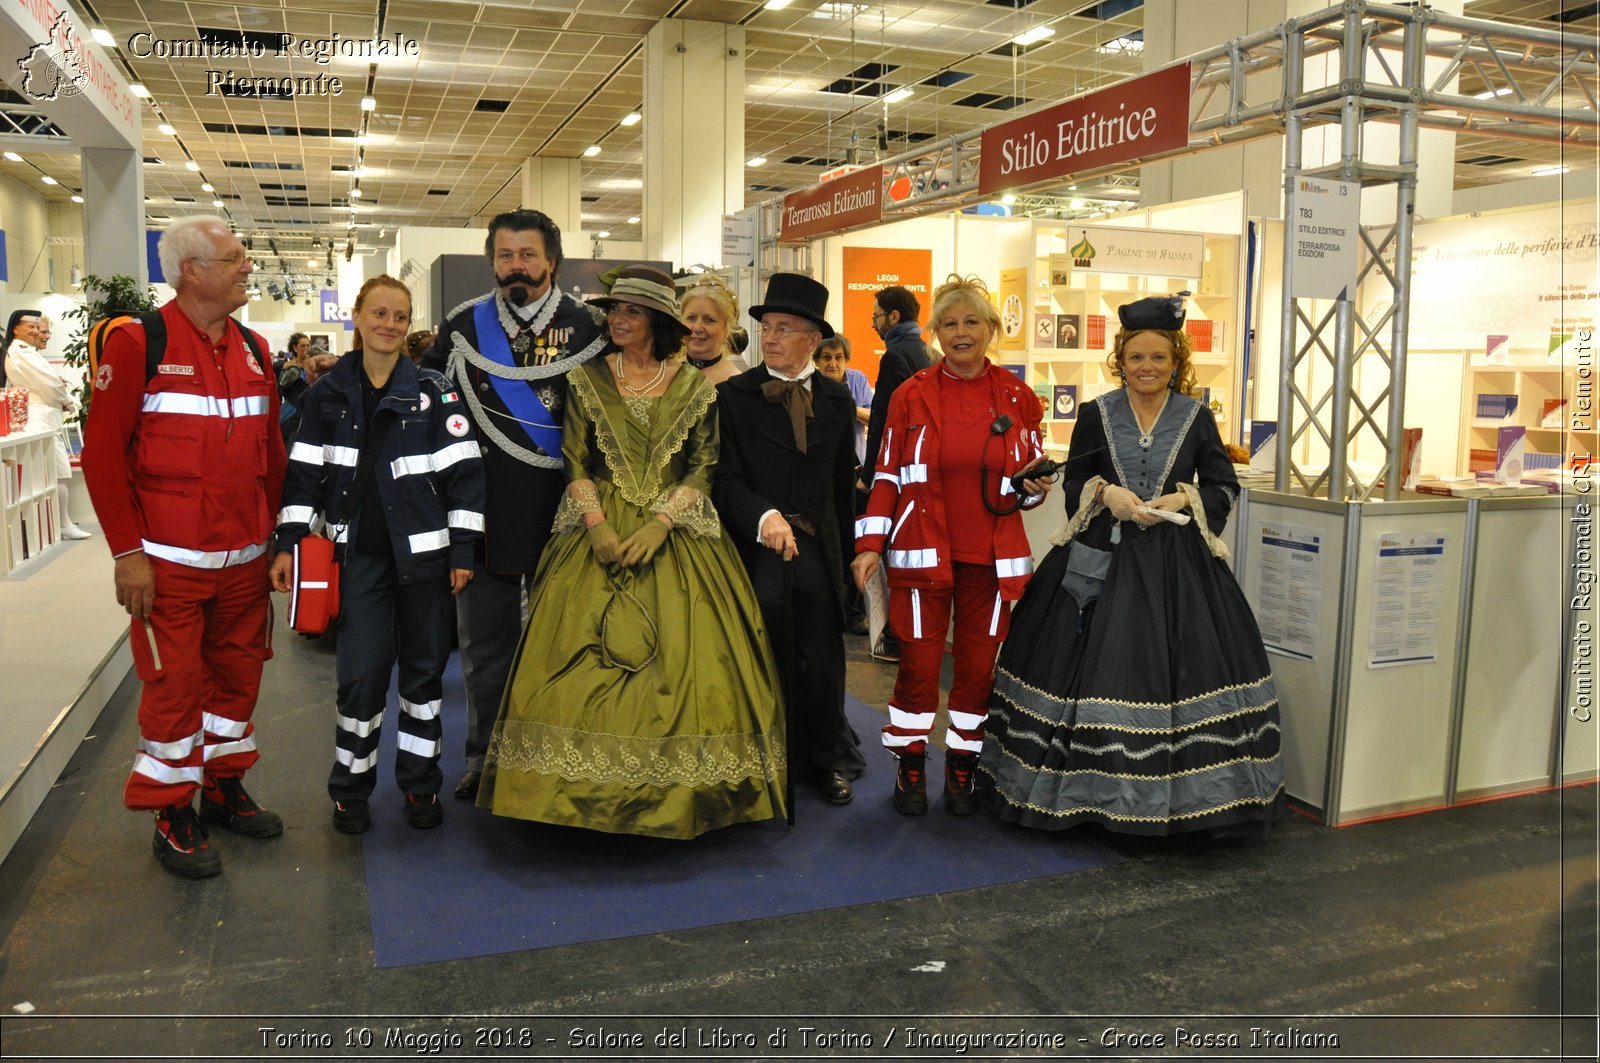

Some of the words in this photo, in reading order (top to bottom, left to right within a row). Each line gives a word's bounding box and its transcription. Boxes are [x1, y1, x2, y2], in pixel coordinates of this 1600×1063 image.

[1001, 131, 1049, 175] Stilo
[1056, 103, 1156, 160] Editrice
[787, 201, 831, 227] Terrarossa
[833, 181, 876, 215] Edizioni
[1299, 207, 1313, 219] T83
[1298, 224, 1317, 234] STILO
[1318, 226, 1346, 237] EDITRICE
[1298, 241, 1341, 252] TERRAROSSA
[1494, 241, 1520, 257] delle
[1520, 237, 1573, 257] periferie
[1576, 233, 1600, 249] d'E
[1298, 249, 1325, 258] EDIZIONI
[876, 274, 899, 282] LEGGI
[160, 365, 193, 374] ALBERTO
